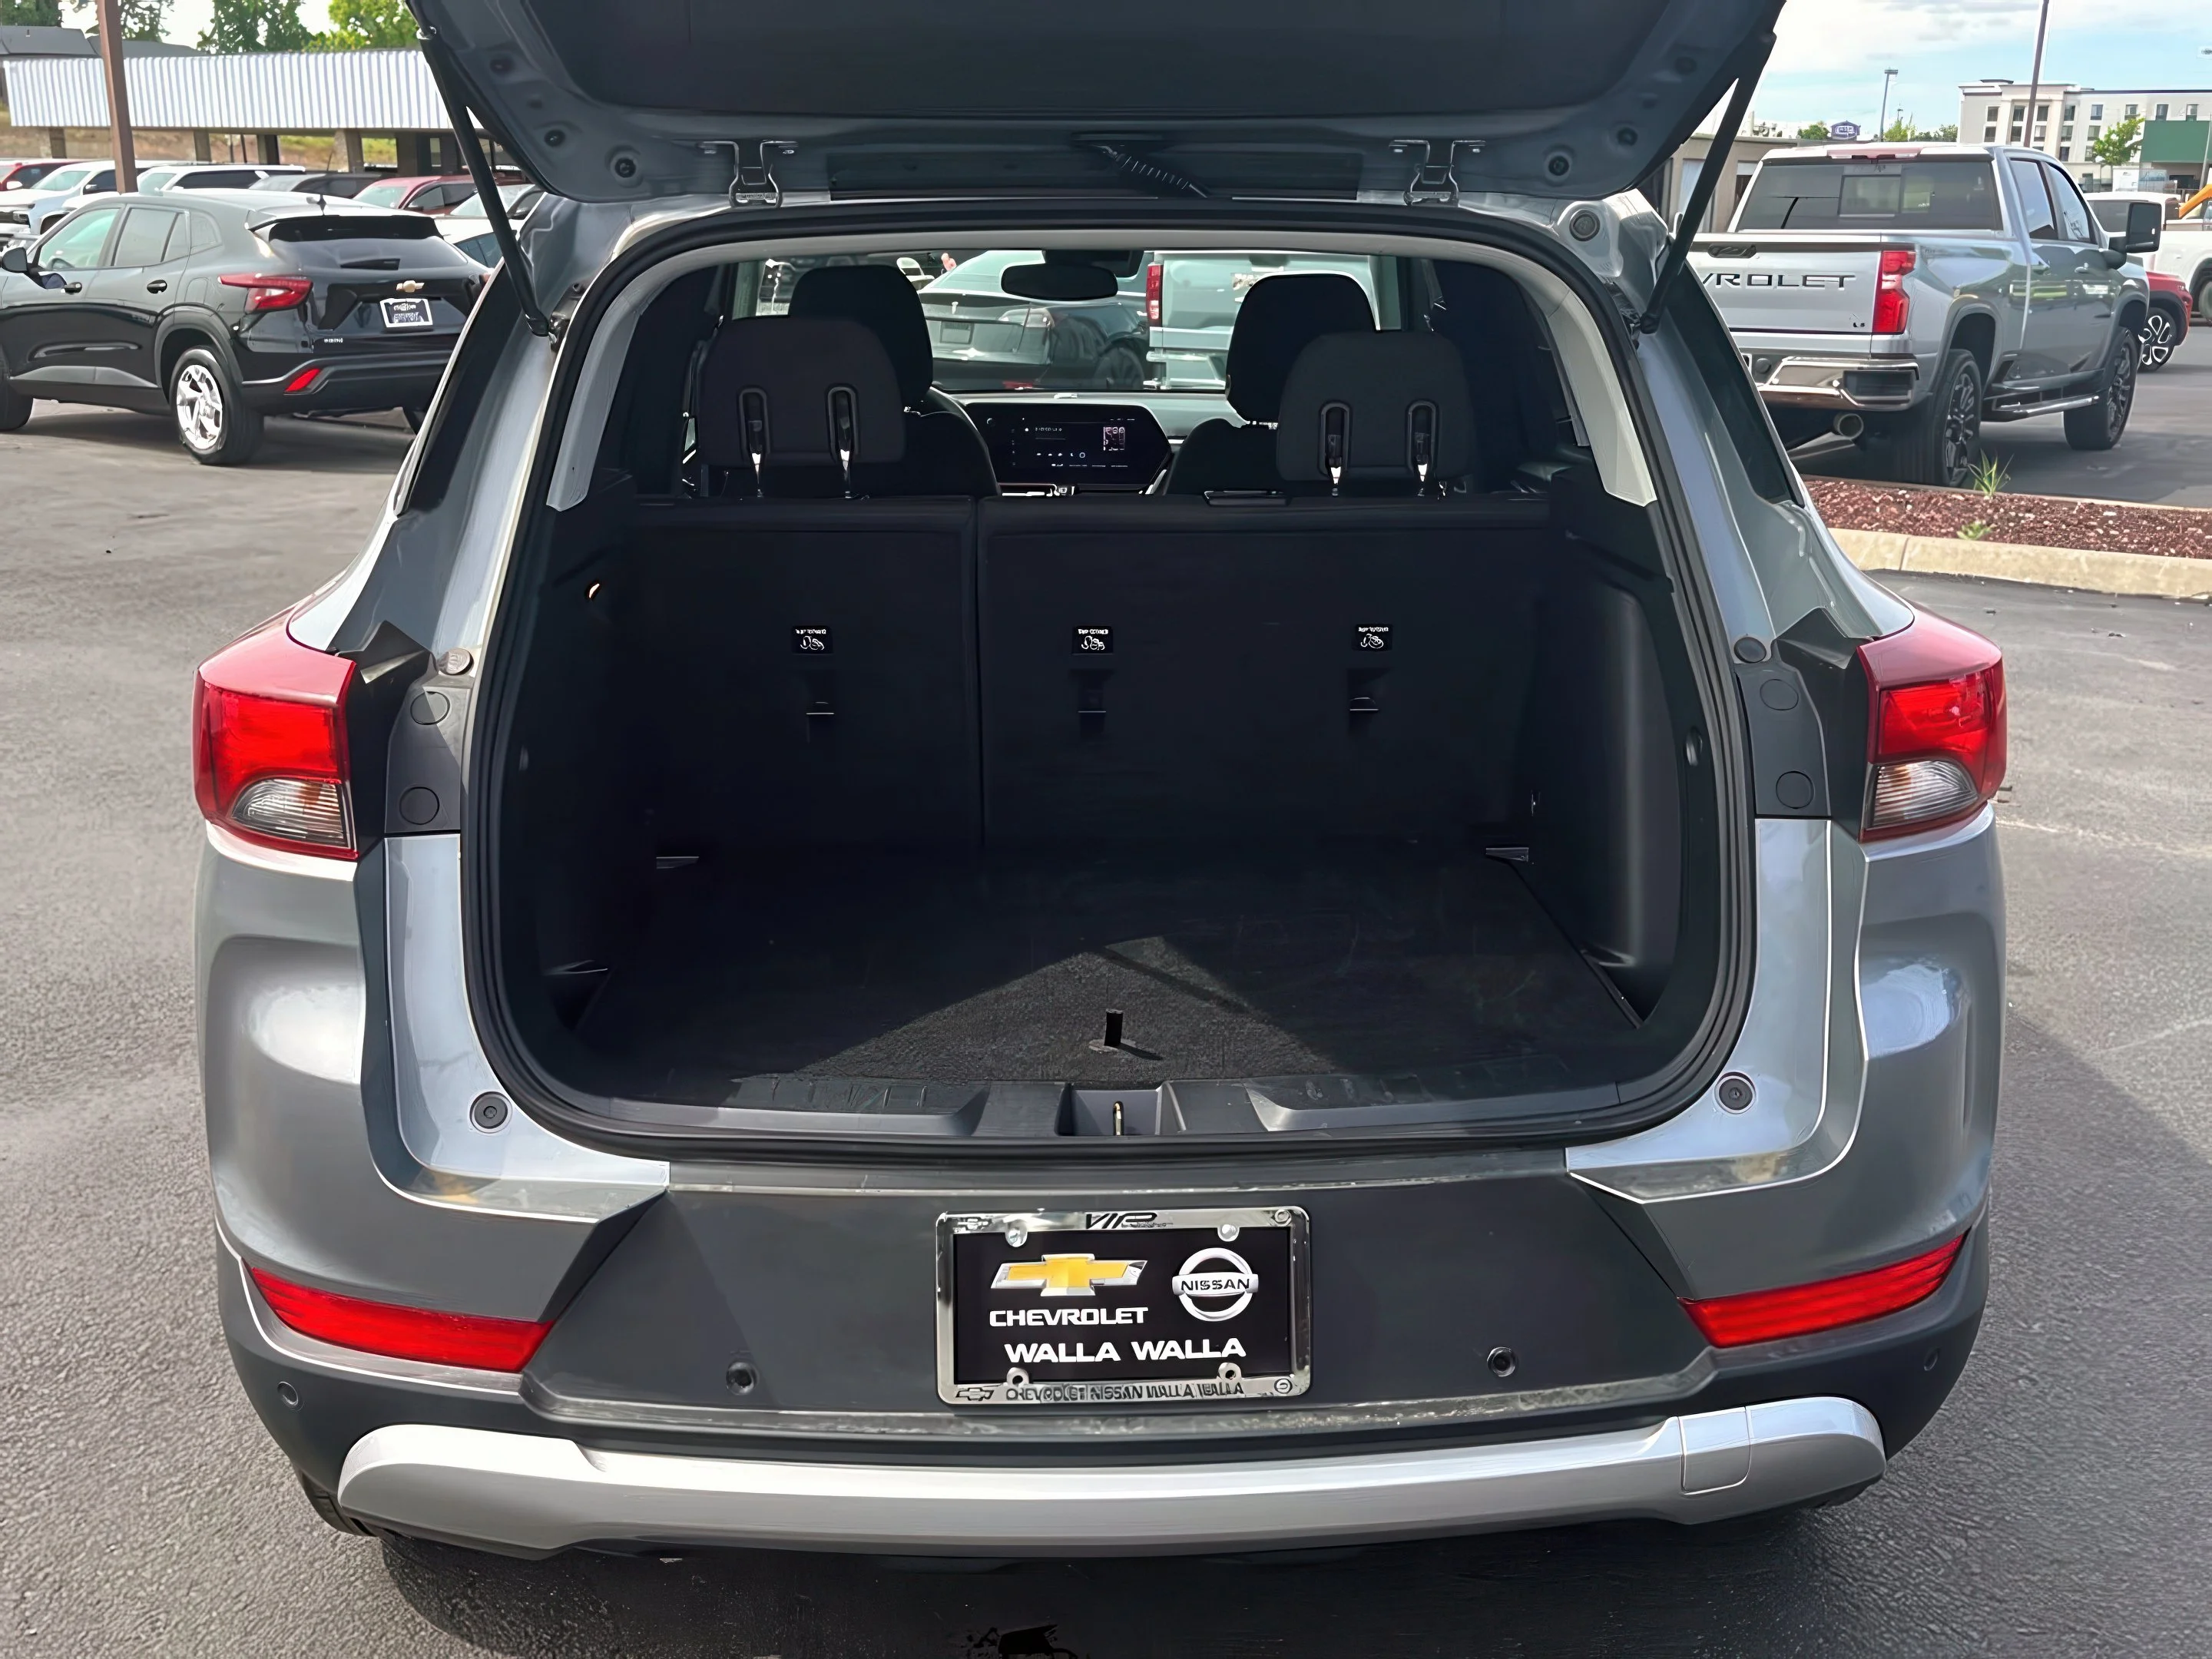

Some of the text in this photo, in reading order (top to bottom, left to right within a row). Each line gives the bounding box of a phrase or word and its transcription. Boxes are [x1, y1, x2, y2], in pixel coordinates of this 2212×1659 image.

[1181, 1277, 1250, 1292] NISSAN
[988, 1306, 1149, 1328] CHEVROLET
[1004, 1337, 1247, 1364] WALLA WALLA
